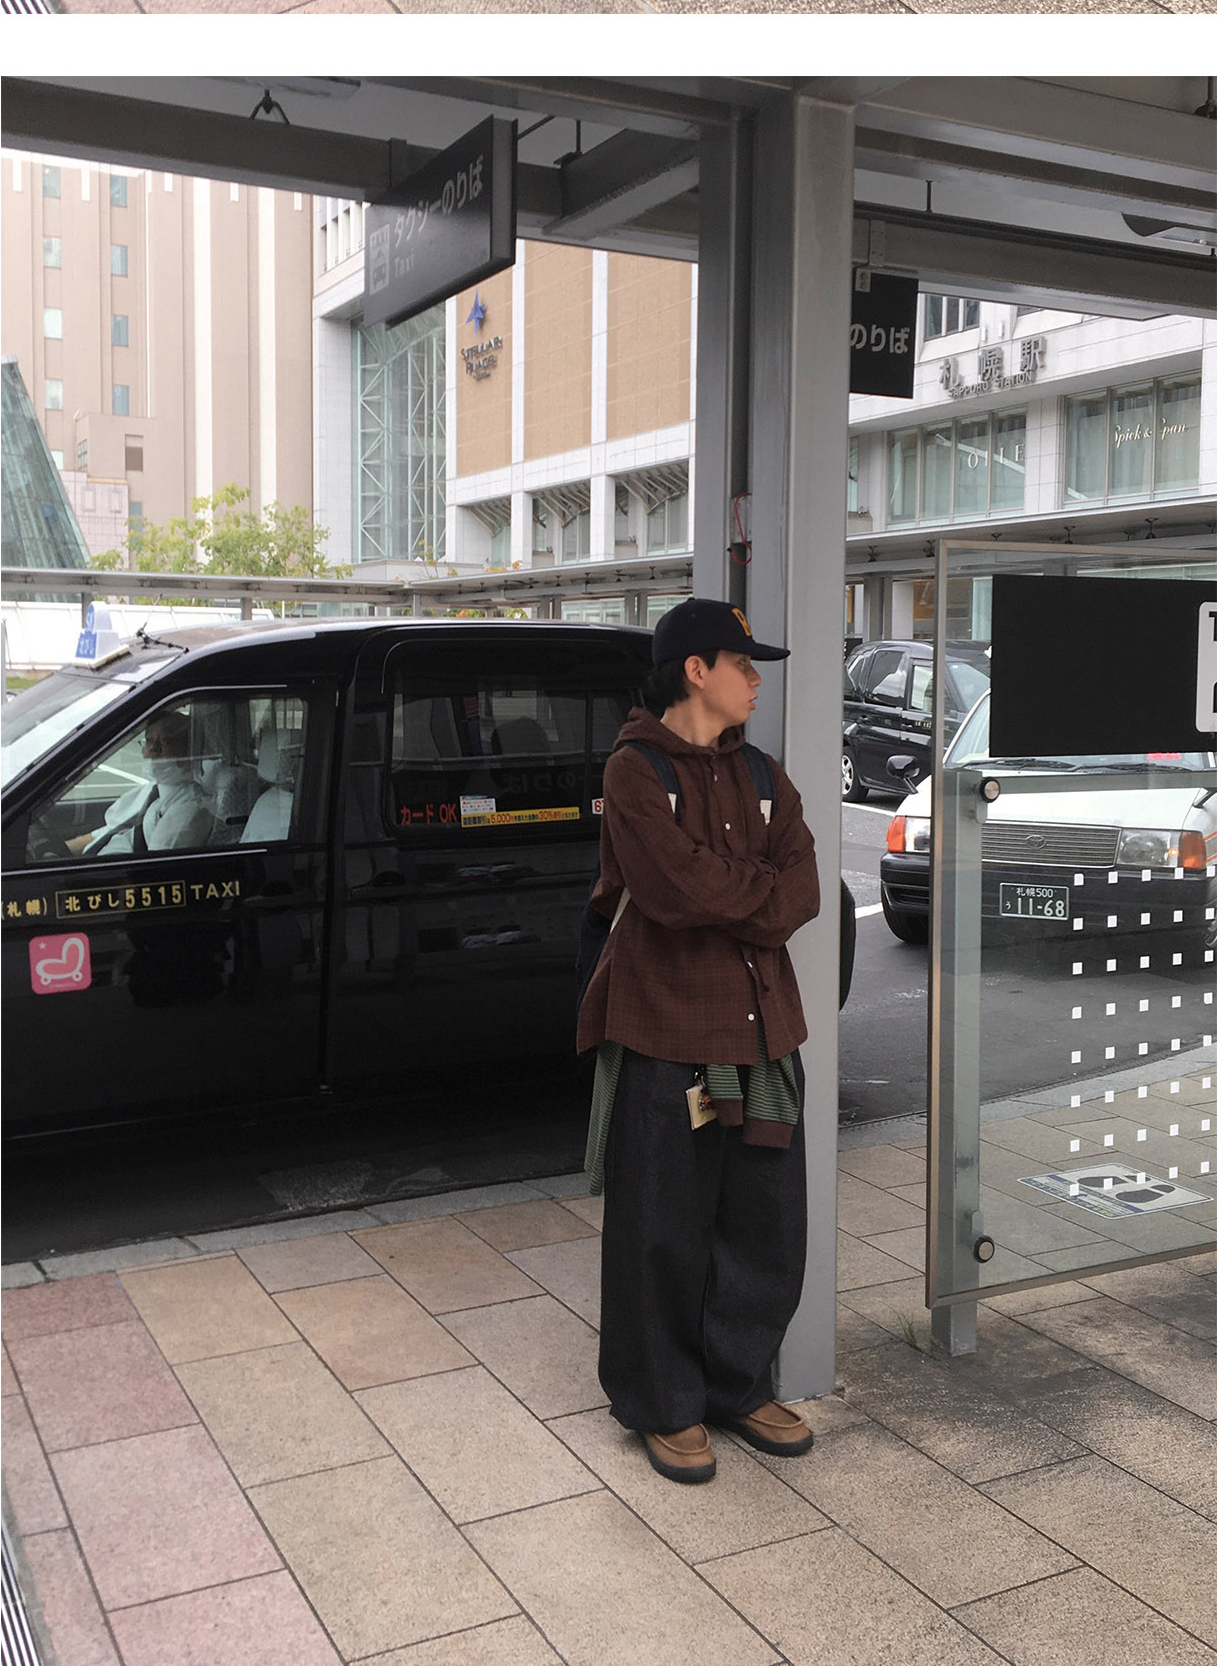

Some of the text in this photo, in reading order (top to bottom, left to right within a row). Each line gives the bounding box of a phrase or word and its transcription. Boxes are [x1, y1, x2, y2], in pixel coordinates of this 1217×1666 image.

[394, 154, 483, 248] タクシーのりば
[850, 323, 910, 354] のりば
[939, 336, 1047, 391] 札幌駅
[401, 804, 434, 826] カード
[439, 804, 457, 823] OK
[190, 881, 240, 900] TAXI
[1016, 887, 1054, 898] 札幌500
[1018, 897, 1065, 917] 11-68
